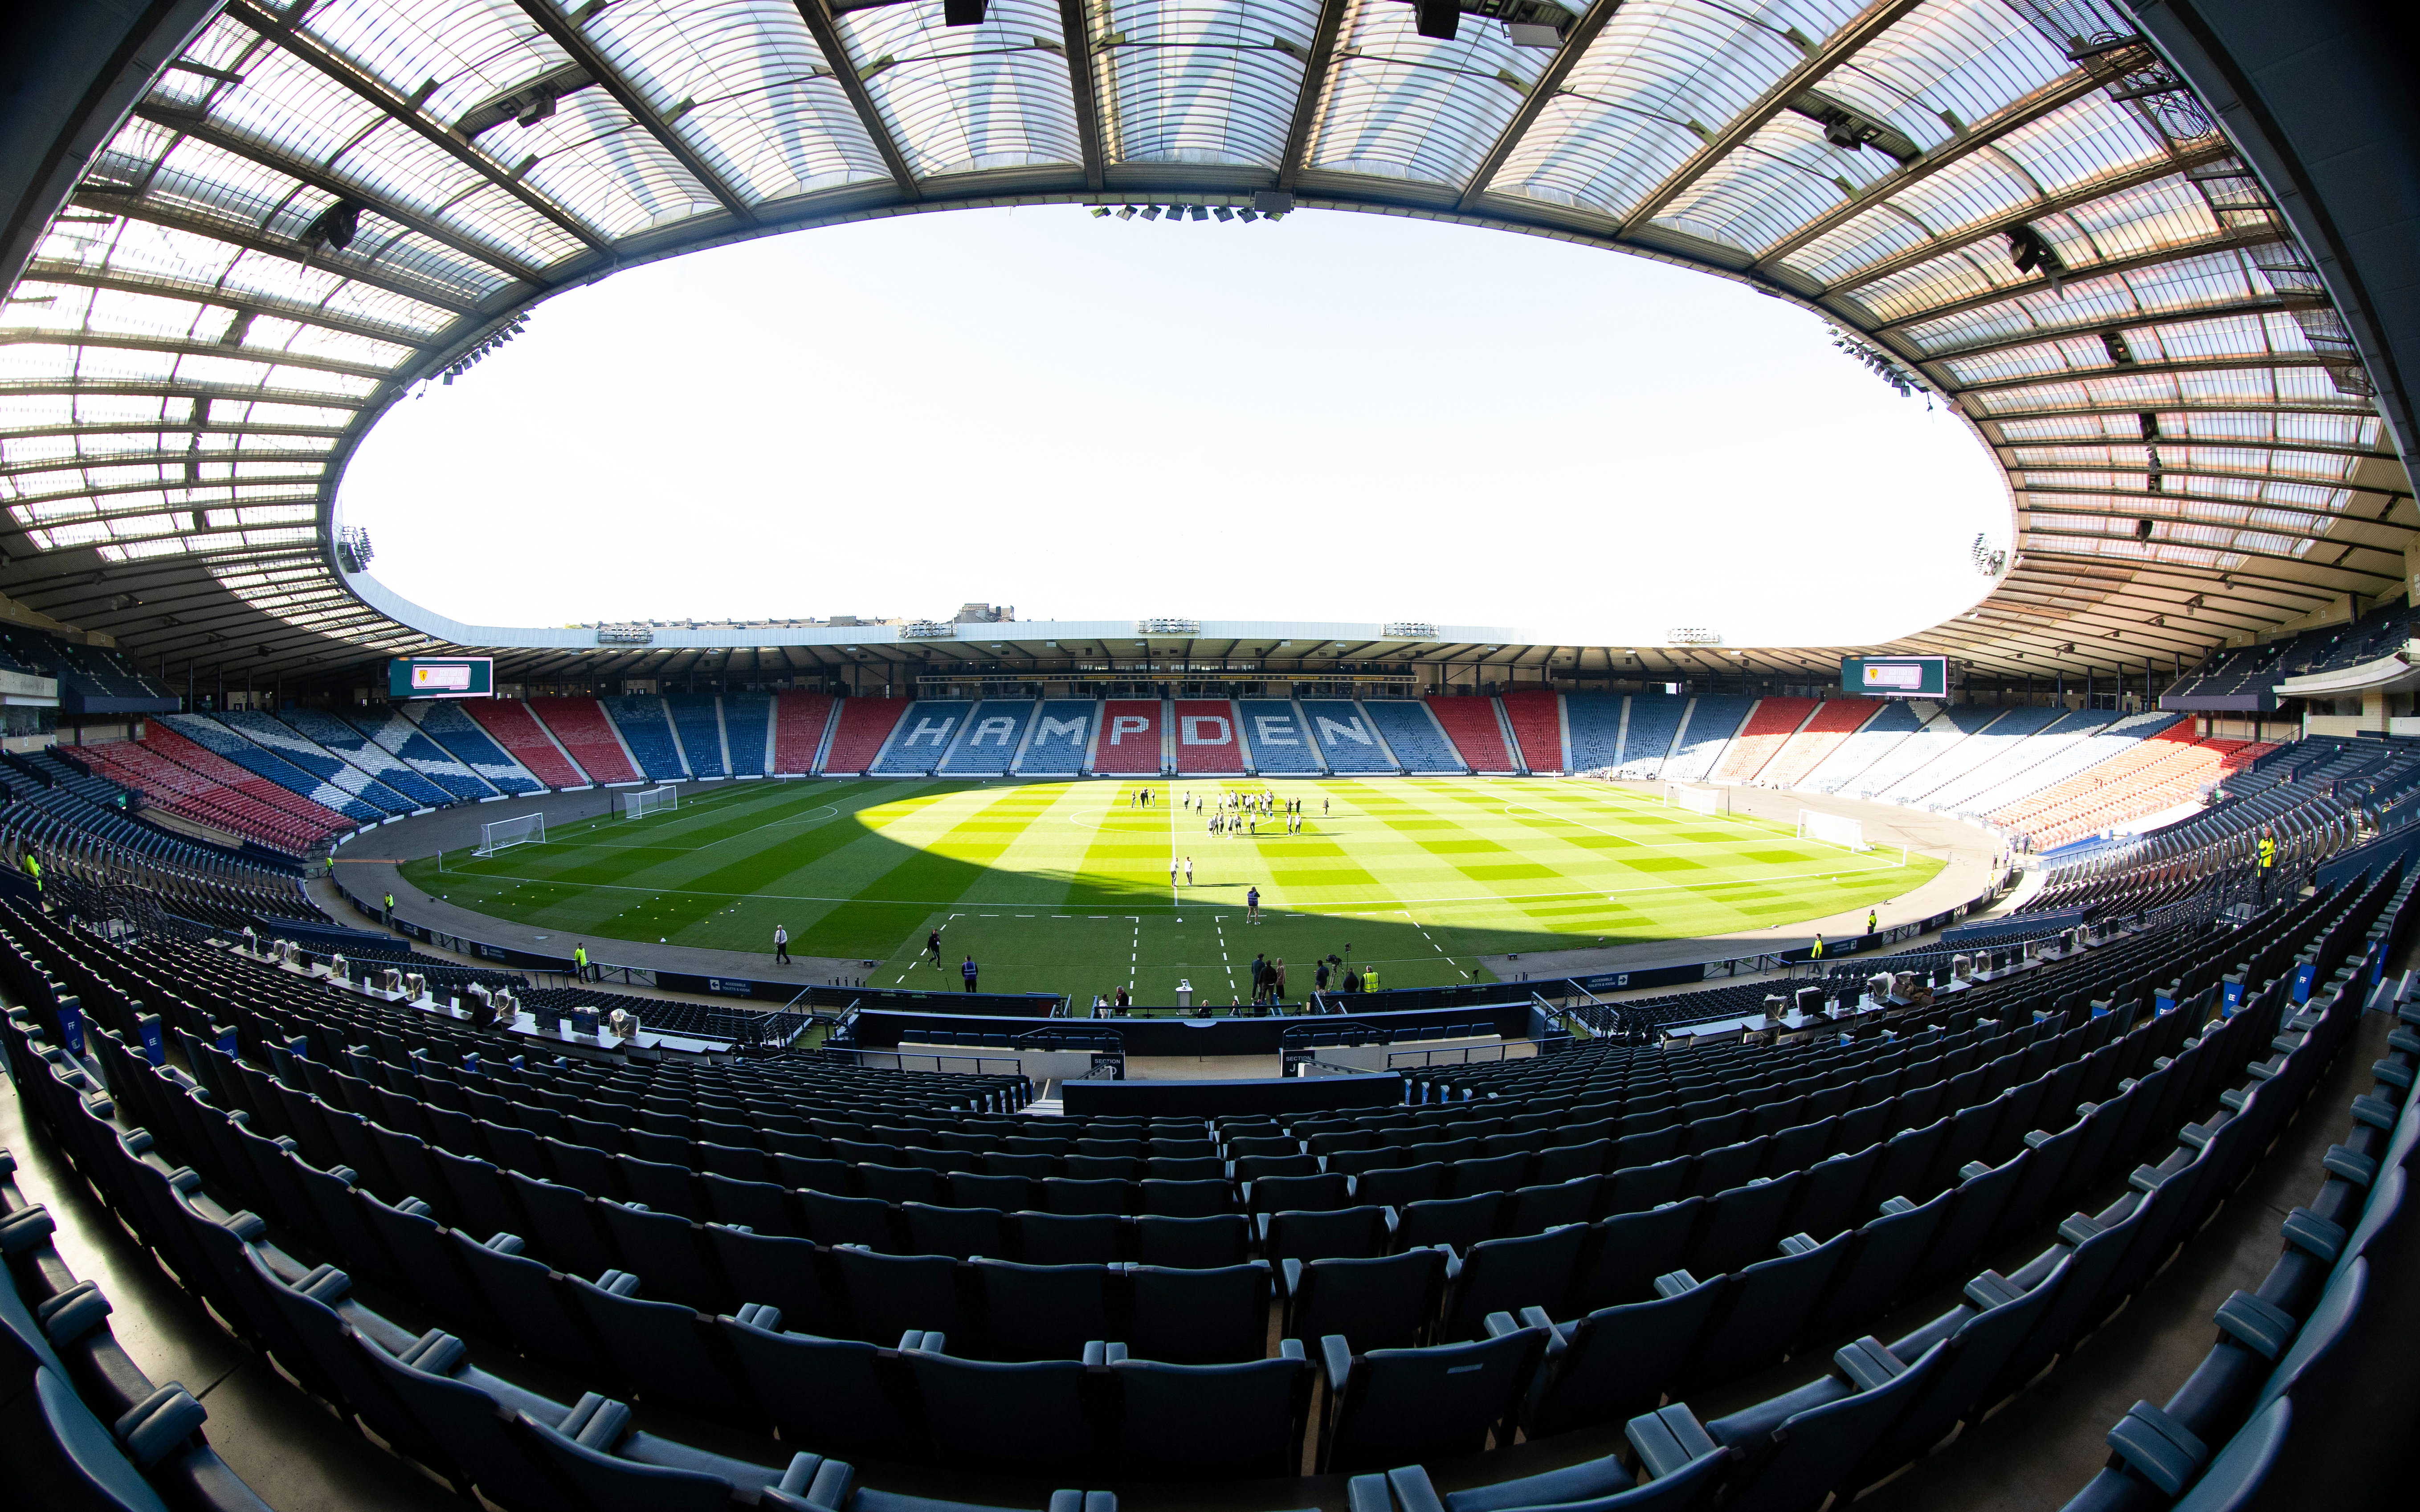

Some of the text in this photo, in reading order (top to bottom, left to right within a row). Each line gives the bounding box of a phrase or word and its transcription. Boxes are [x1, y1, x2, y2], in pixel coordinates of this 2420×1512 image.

[904, 716, 1373, 745] HAMPDEN
[68, 1021, 75, 1031] FF
[149, 1037, 157, 1046] EE
[1290, 1064, 1296, 1072] J
